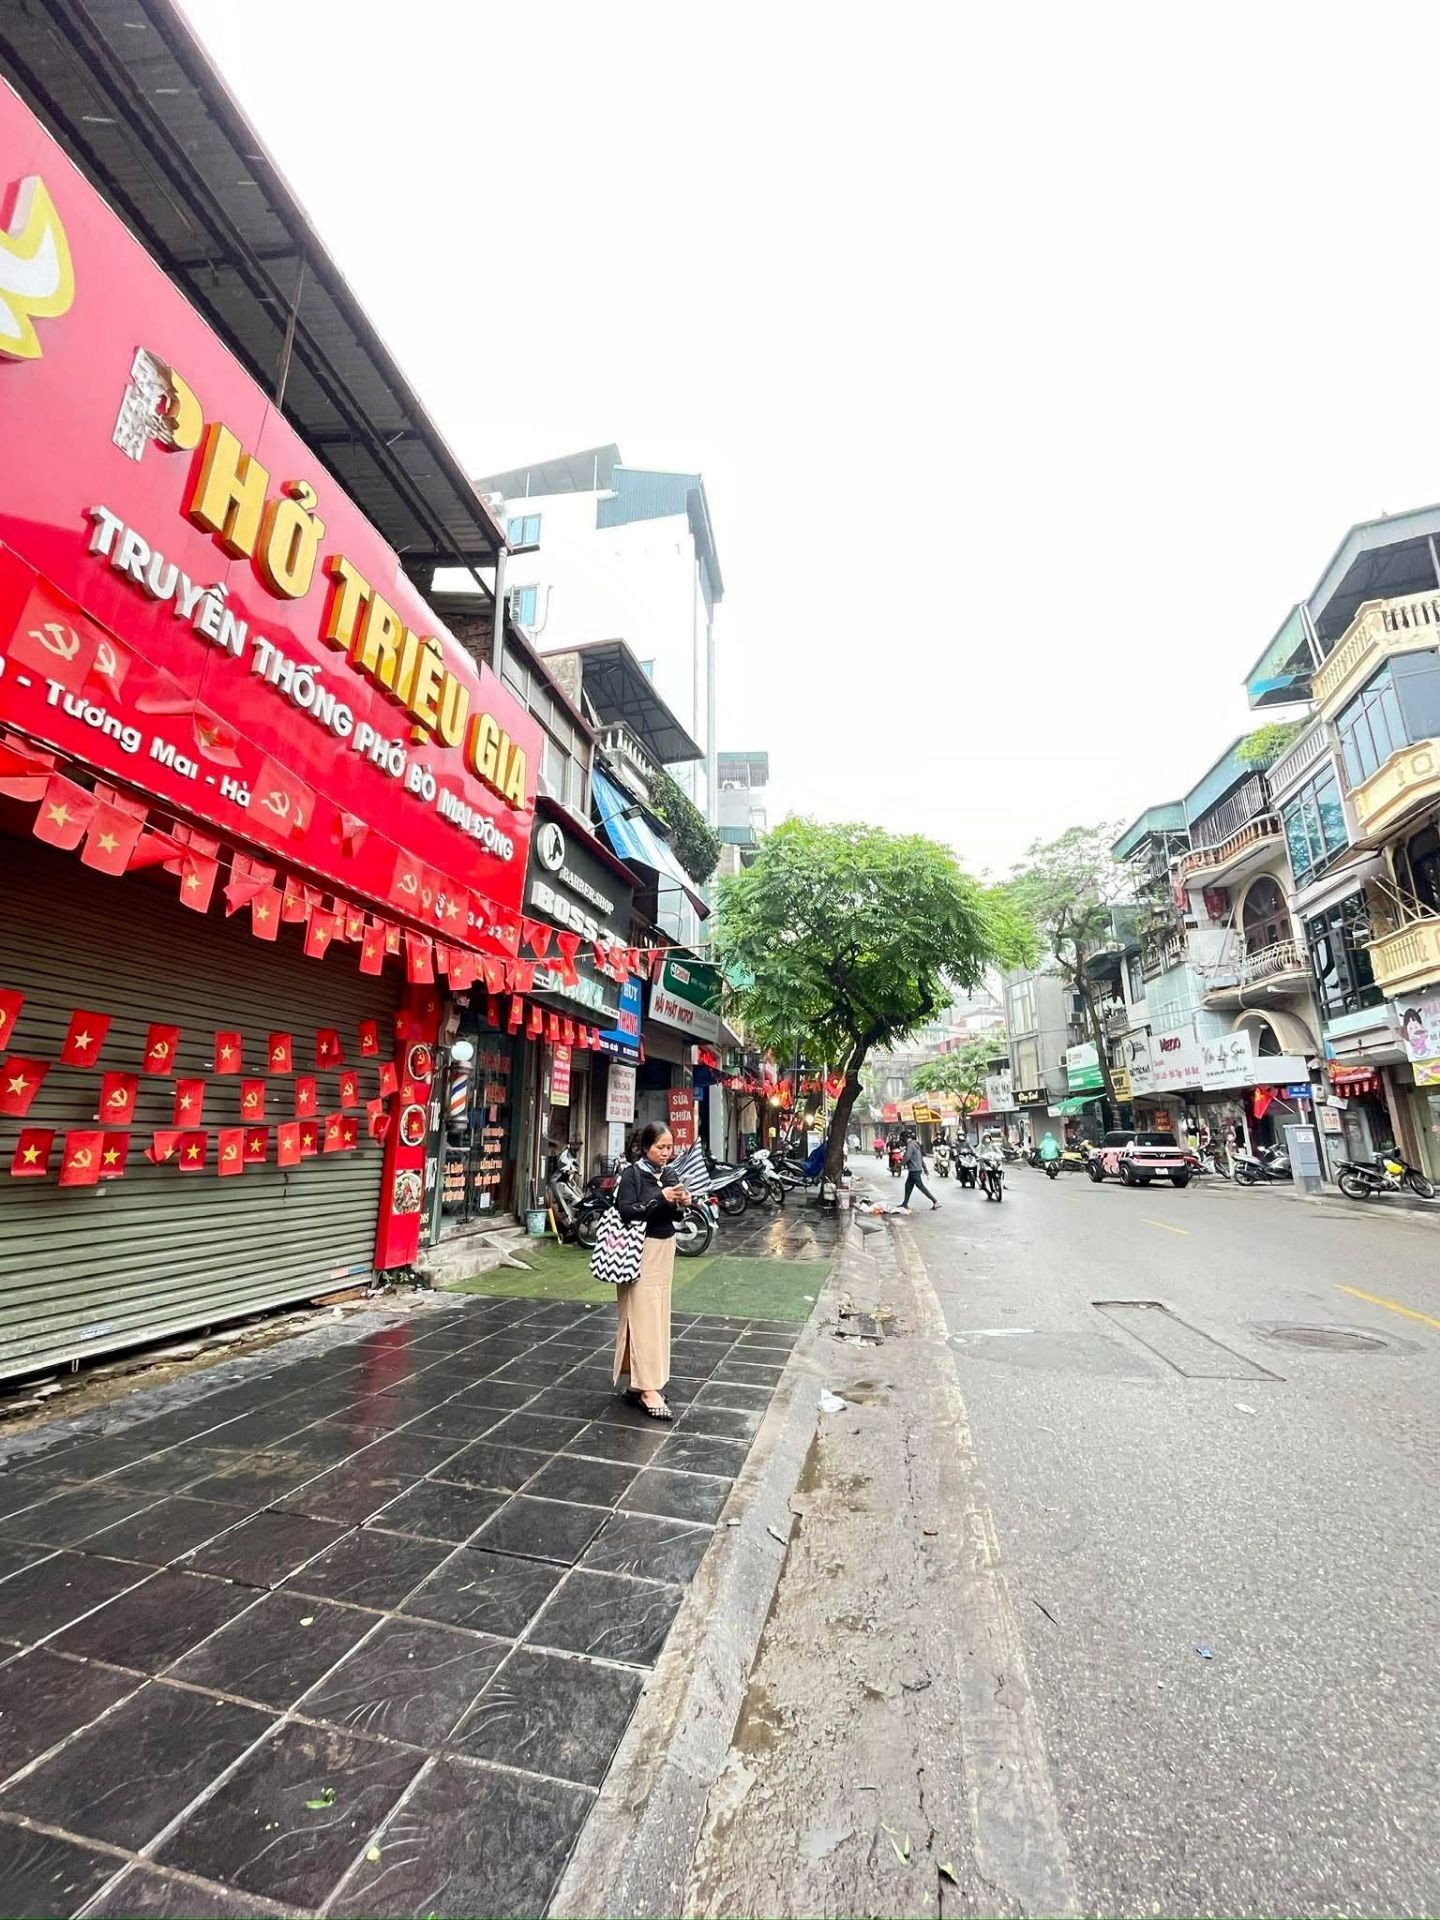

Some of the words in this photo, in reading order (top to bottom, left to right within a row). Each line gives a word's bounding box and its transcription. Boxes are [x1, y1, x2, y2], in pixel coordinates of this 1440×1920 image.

[112, 346, 326, 599] PHỞ
[326, 554, 470, 748] TRIỆU
[470, 712, 527, 811] GIA
[46, 678, 143, 754] Tương
[149, 736, 198, 780] Mai
[220, 775, 251, 808] Hà
[89, 505, 248, 657] TRUYỀN
[251, 636, 354, 737] THỐNG
[352, 722, 407, 777] PHỞ
[404, 763, 436, 801] BÒ
[436, 788, 472, 832] MAI
[470, 816, 513, 862] ĐỘNG
[531, 881, 599, 943] BOSS
[676, 1127, 687, 1139] XE
